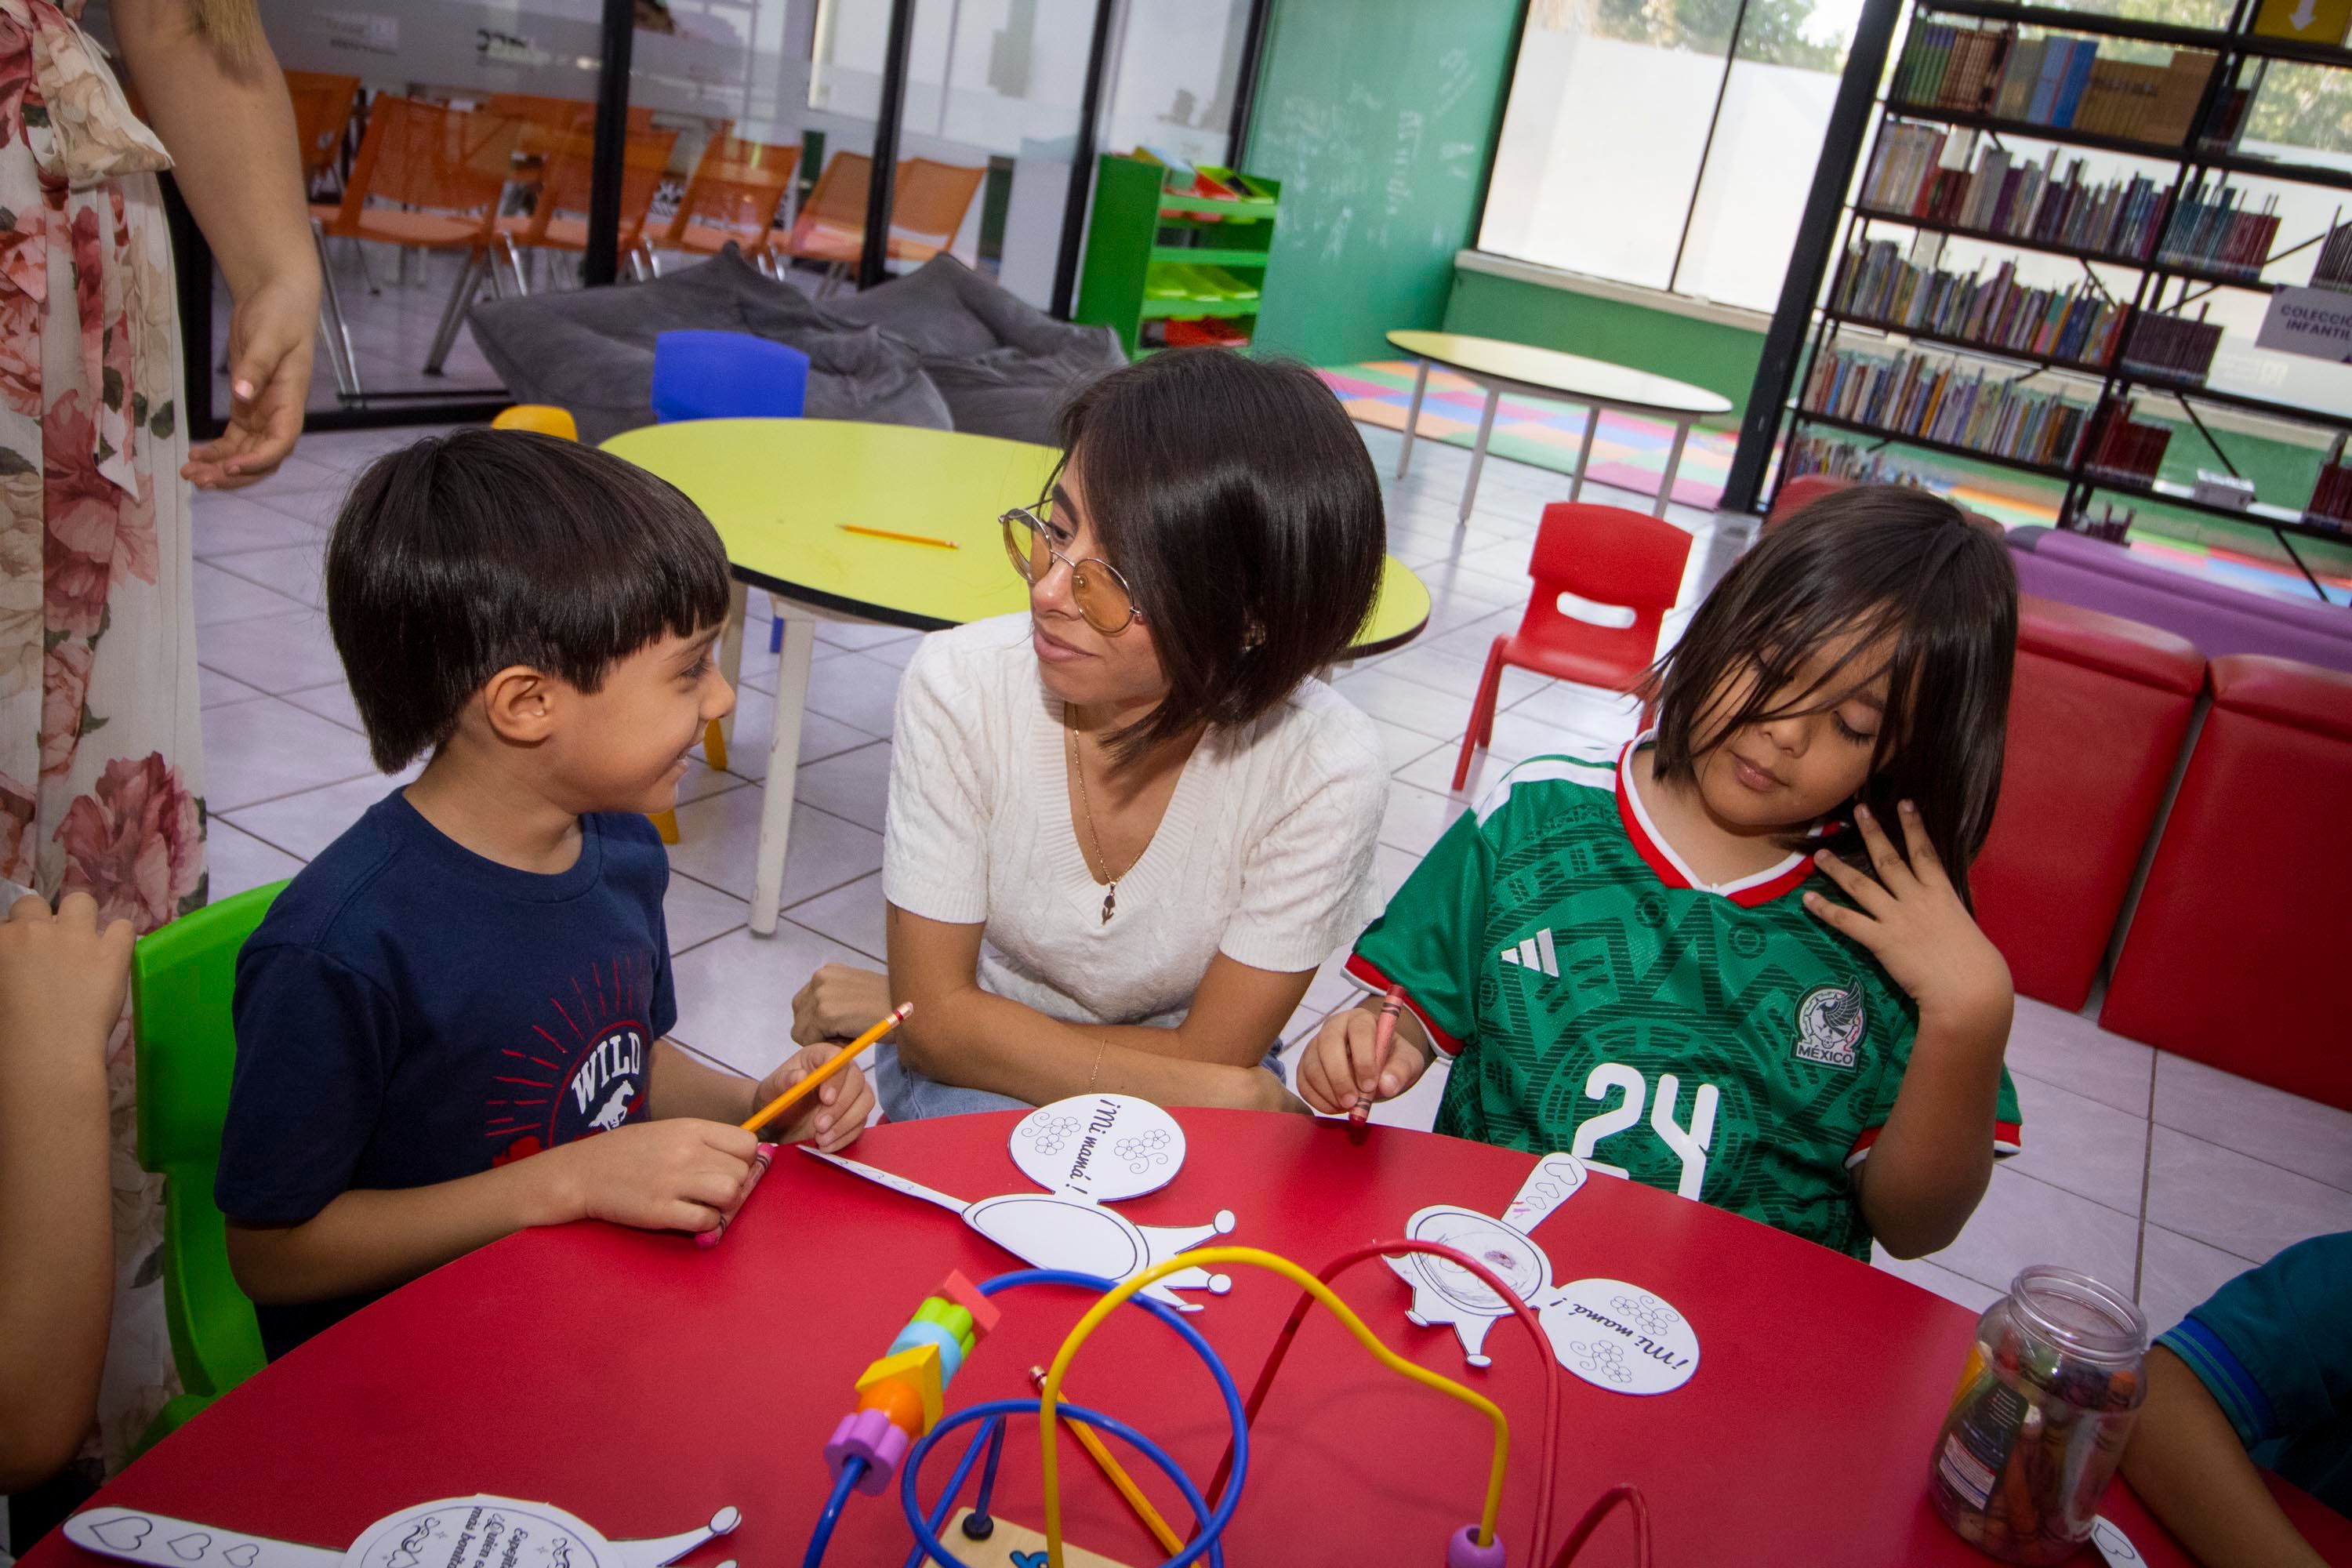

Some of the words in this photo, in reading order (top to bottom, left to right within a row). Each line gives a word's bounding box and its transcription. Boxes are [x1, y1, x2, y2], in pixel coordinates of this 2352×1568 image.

[2286, 319, 2350, 341] INFANTIL
[572, 1032, 641, 1114] WILD
[1798, 1044, 1853, 1065] MÉXICO
[1571, 1062, 1719, 1202] 24
